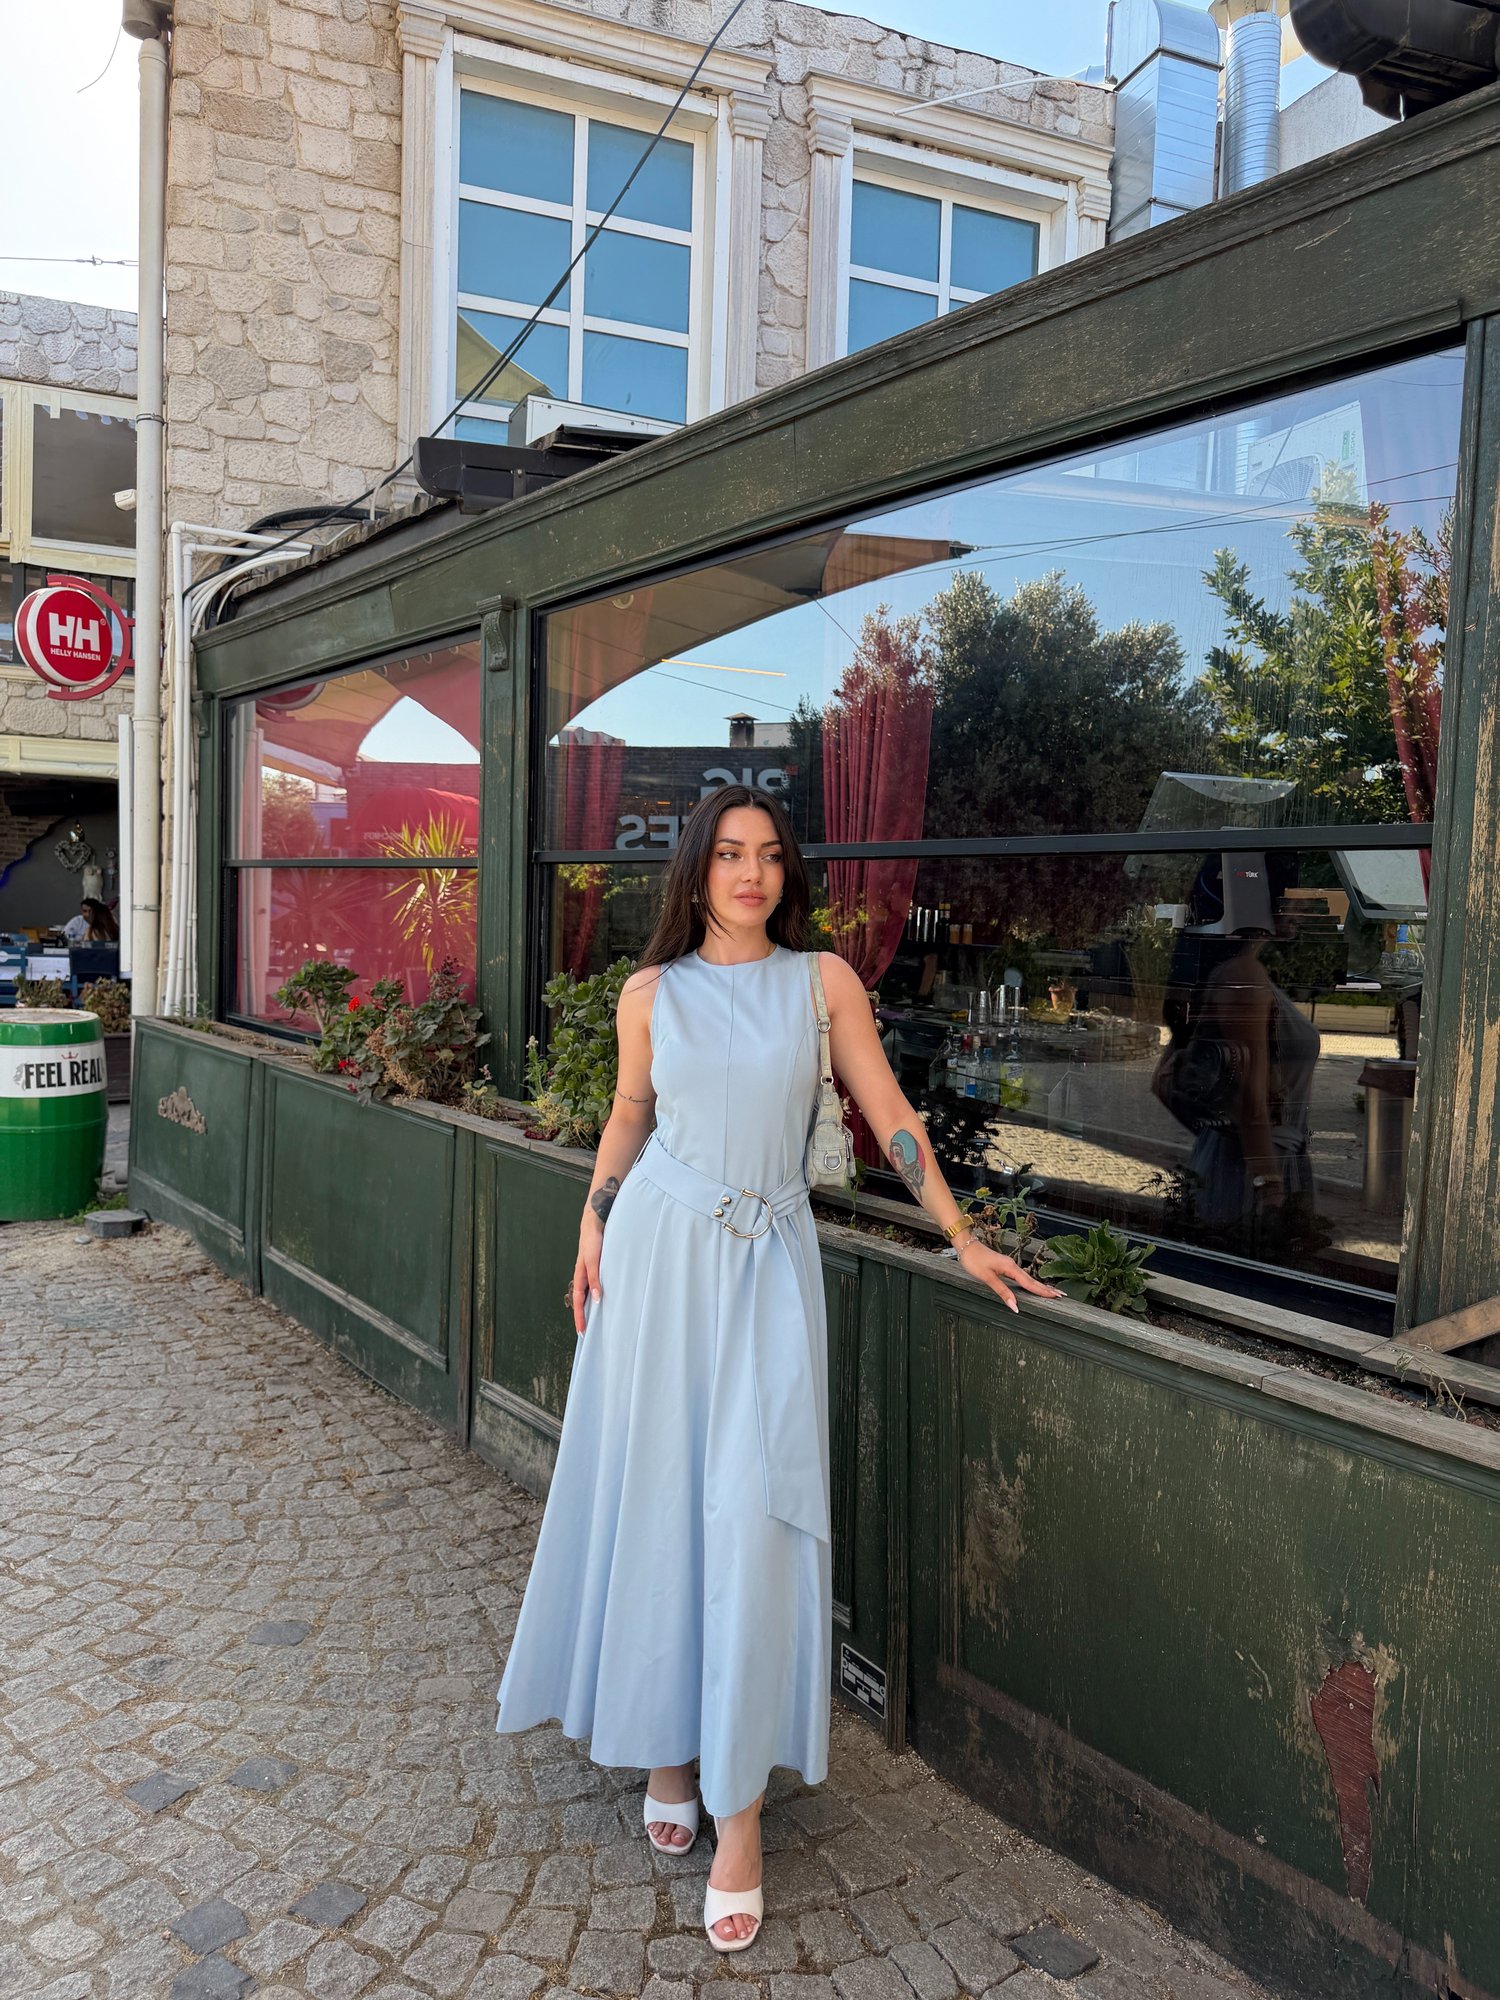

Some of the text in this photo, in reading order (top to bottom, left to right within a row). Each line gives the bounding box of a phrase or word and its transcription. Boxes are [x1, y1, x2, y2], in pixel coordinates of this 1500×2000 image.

[49, 612, 100, 652] HH
[50, 648, 100, 661] HELLY HANSEN
[24, 1058, 102, 1089] FEEL REAL
